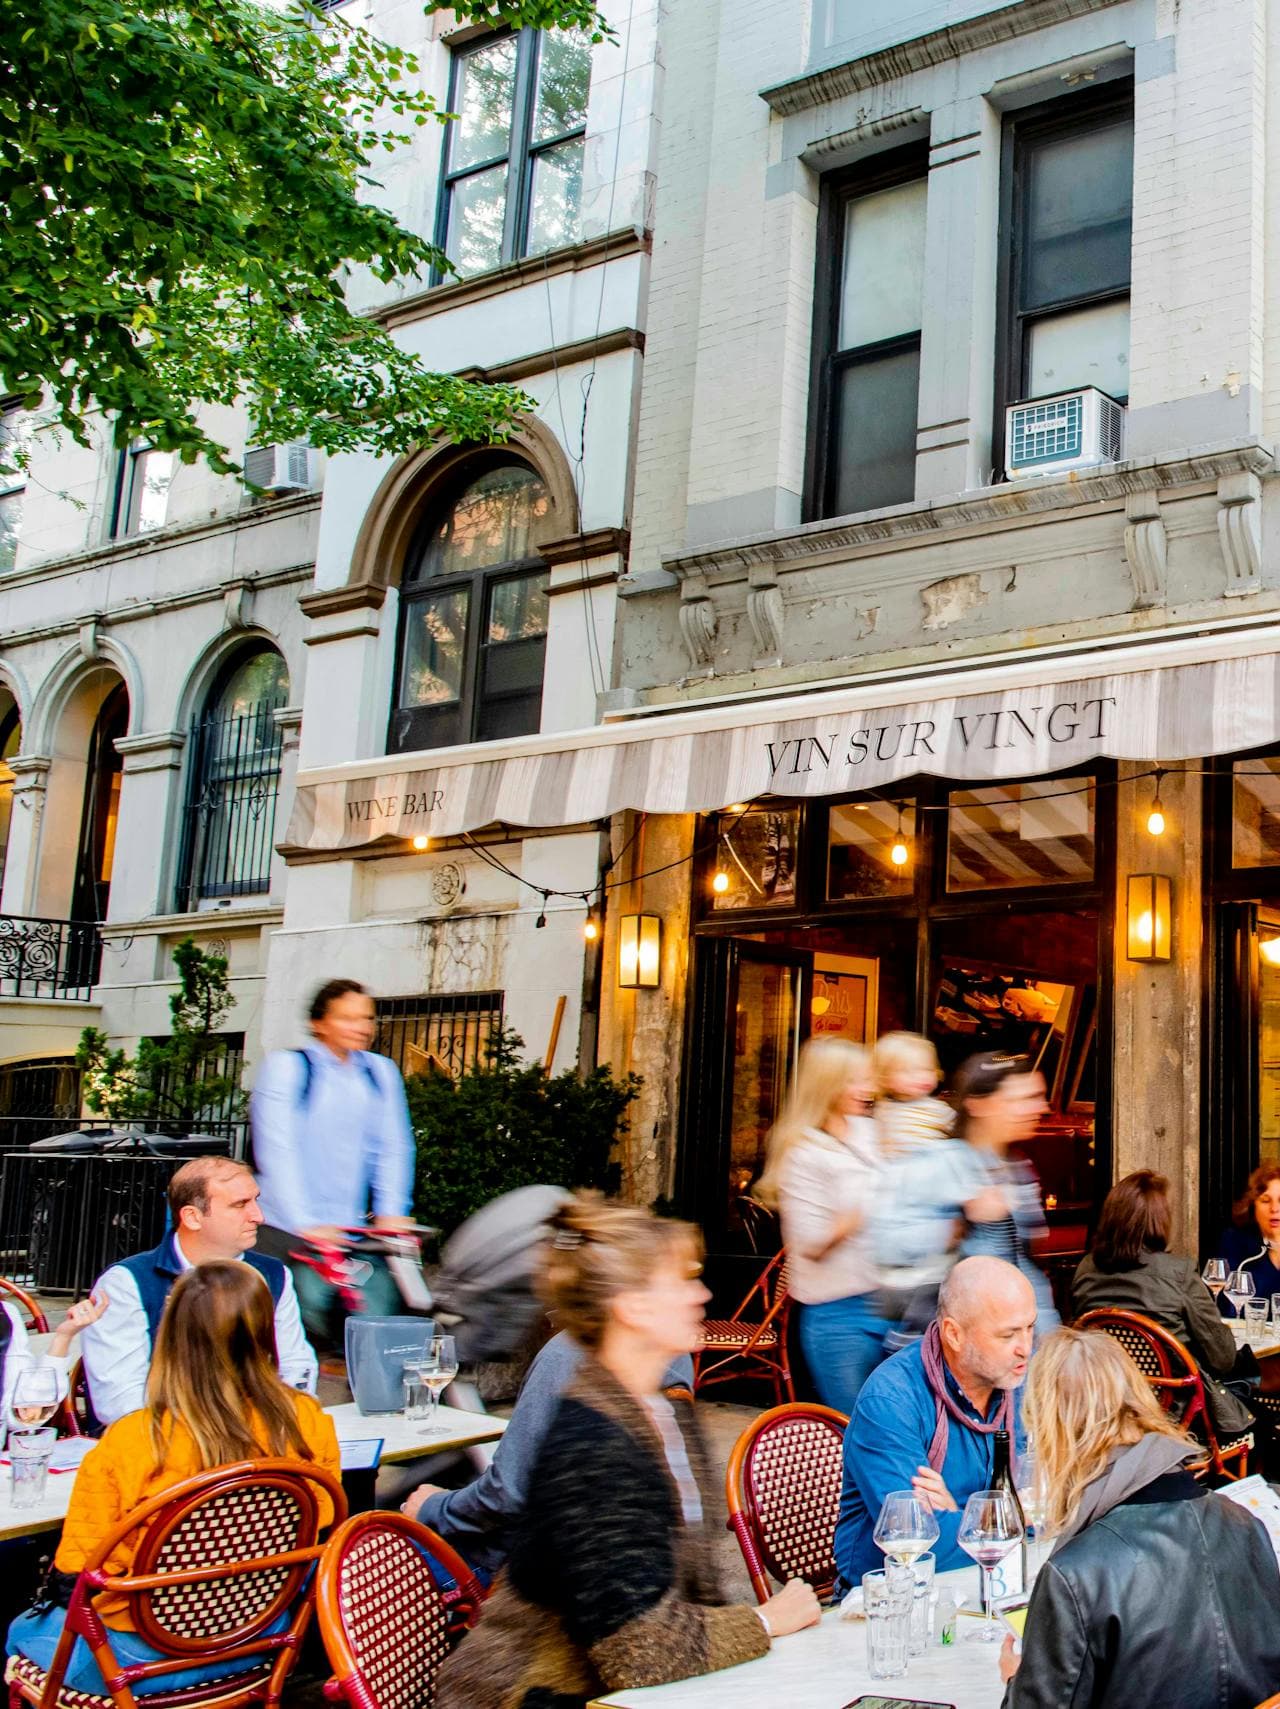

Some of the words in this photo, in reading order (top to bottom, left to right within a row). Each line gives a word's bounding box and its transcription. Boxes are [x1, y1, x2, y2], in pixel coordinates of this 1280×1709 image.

[764, 733, 839, 777] VIN
[845, 720, 936, 766] SUR
[954, 697, 1116, 753] VINGT
[346, 795, 398, 821] WINE
[402, 790, 444, 815] BAR
